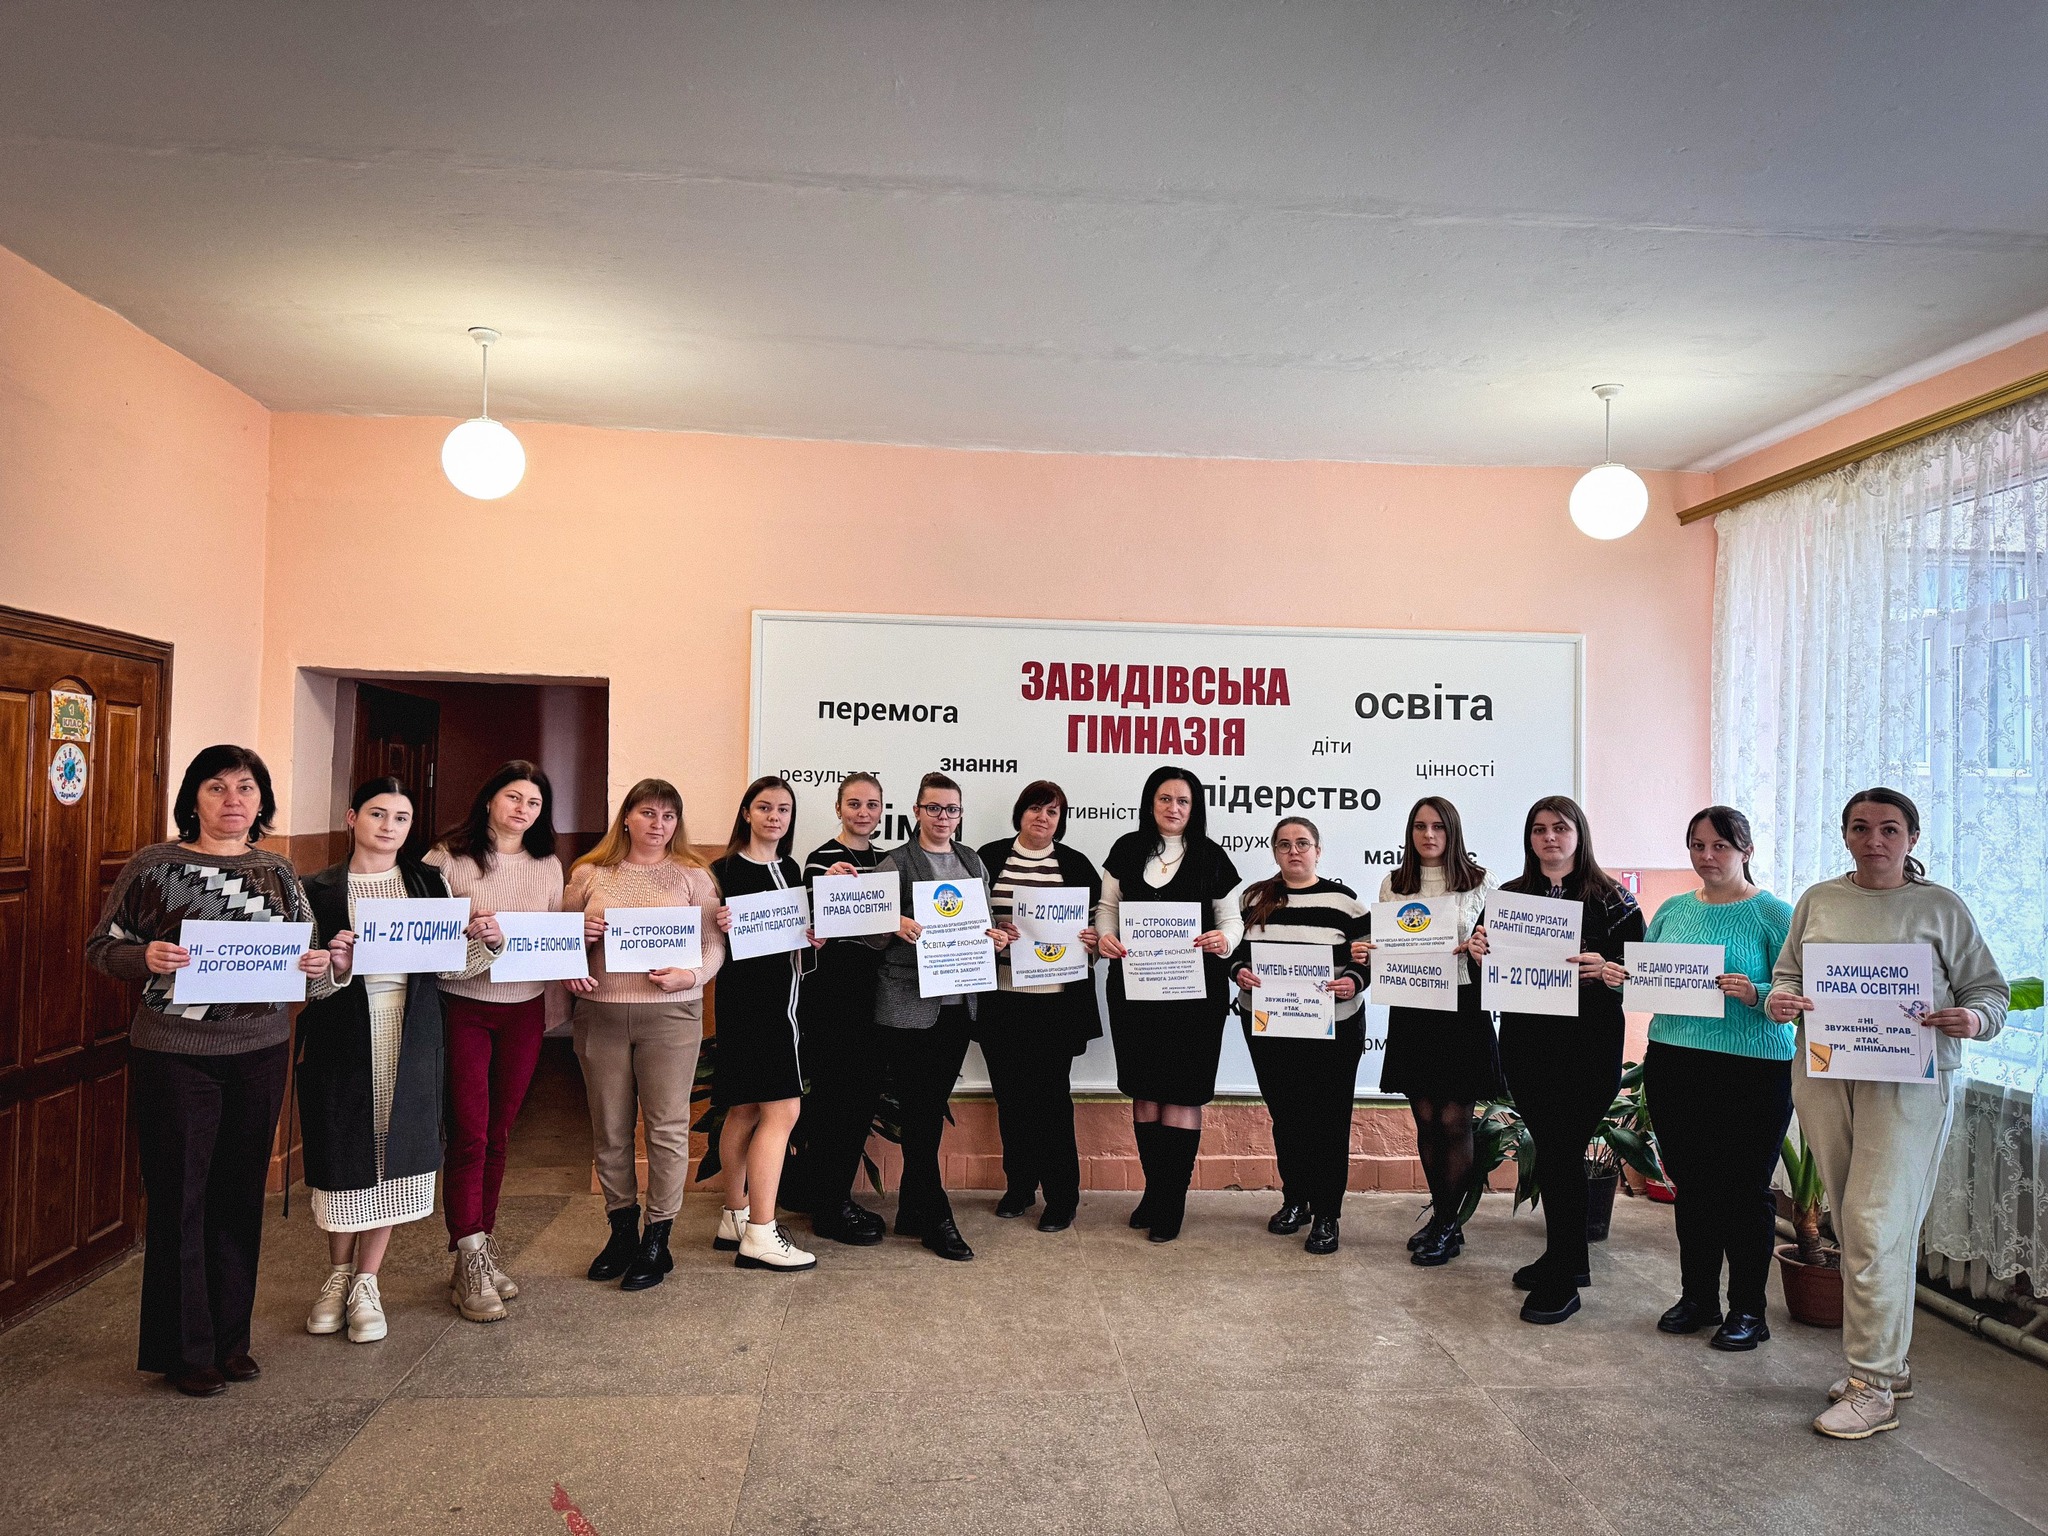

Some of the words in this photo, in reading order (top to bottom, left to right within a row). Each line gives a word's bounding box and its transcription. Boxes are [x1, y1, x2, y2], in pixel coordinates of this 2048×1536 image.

[1021, 661, 1290, 709] ЗАВИДІВСЬКА
[68, 703, 75, 716] 1
[1354, 683, 1493, 721] освіта
[818, 700, 959, 725] перемога
[62, 717, 82, 728] КЛАС
[1067, 714, 1245, 756] ГІМНАЗІЯ
[1312, 737, 1351, 755] діти
[940, 757, 1018, 773] знання
[1416, 760, 1494, 779] цінності
[1202, 776, 1381, 815] лідерство
[1221, 835, 1270, 852] друж
[829, 890, 885, 902] ЗАХИЩАЄМО
[739, 912, 749, 922] НЕ
[750, 909, 770, 923] ДАМО
[772, 905, 799, 918] УРІЗАТИ
[823, 905, 851, 916] ПРАВА
[852, 902, 892, 914] ОСВІТЯН!
[1018, 902, 1026, 918] НІ
[1035, 905, 1045, 920] 22
[1048, 904, 1084, 923] ГОДИНИ!
[1125, 918, 1133, 927] НІ
[1142, 918, 1196, 927] СТРОКОВИМ
[1498, 909, 1509, 918] НЕ
[1510, 911, 1533, 922] ДАМО
[1536, 914, 1568, 926] УРІЗАТИ
[364, 922, 376, 942] НІ
[389, 922, 404, 942] 22
[406, 920, 462, 945] ГОДИНИ!
[612, 927, 622, 936] НІ
[632, 925, 695, 936] СТРОКОВИМ
[734, 924, 764, 936] ГАРАНТІЇ
[765, 916, 806, 931] ПЕДАГОГАМ!
[1490, 920, 1523, 933] ГАРАНТІЇ
[1525, 925, 1574, 940] ПЕДАГОГАМ!
[1132, 929, 1189, 939] ДОГОВОРАМ!
[188, 944, 203, 956] НІ
[218, 944, 300, 956] СТРОКОВИМ
[506, 938, 532, 952] ИТЕЛЬ
[540, 937, 581, 952] ЕКОНОМІЯ
[620, 938, 686, 950] ДОГОВОРАМ!
[923, 940, 946, 950] ОСВІТА
[958, 939, 988, 947] ЕКОНОМІЯ
[198, 960, 287, 973] ДОГОВОРАМ!
[1256, 963, 1287, 975] УЧИТЕЛЬ
[1294, 965, 1330, 977] ЕКОНОМІЯ
[1387, 963, 1442, 976] ЗАХИЩАЄМО
[1638, 962, 1647, 972] НЕ
[1649, 963, 1672, 974] ДАМО
[1675, 963, 1709, 975] УРІЗАТИ
[1826, 965, 1909, 980] ЗАХИЩАЄМО
[1380, 976, 1407, 986] ПРАВА
[1409, 978, 1448, 989] ОСВІТЯН!
[1489, 966, 1498, 983] НІ
[1510, 967, 1522, 984] 22
[1525, 968, 1572, 990] ГОДИНИ!
[1630, 976, 1662, 987] ГАРАНТІЇ
[1817, 981, 1857, 994] ПРАВА
[1861, 983, 1920, 995] ОСВІТЯН!
